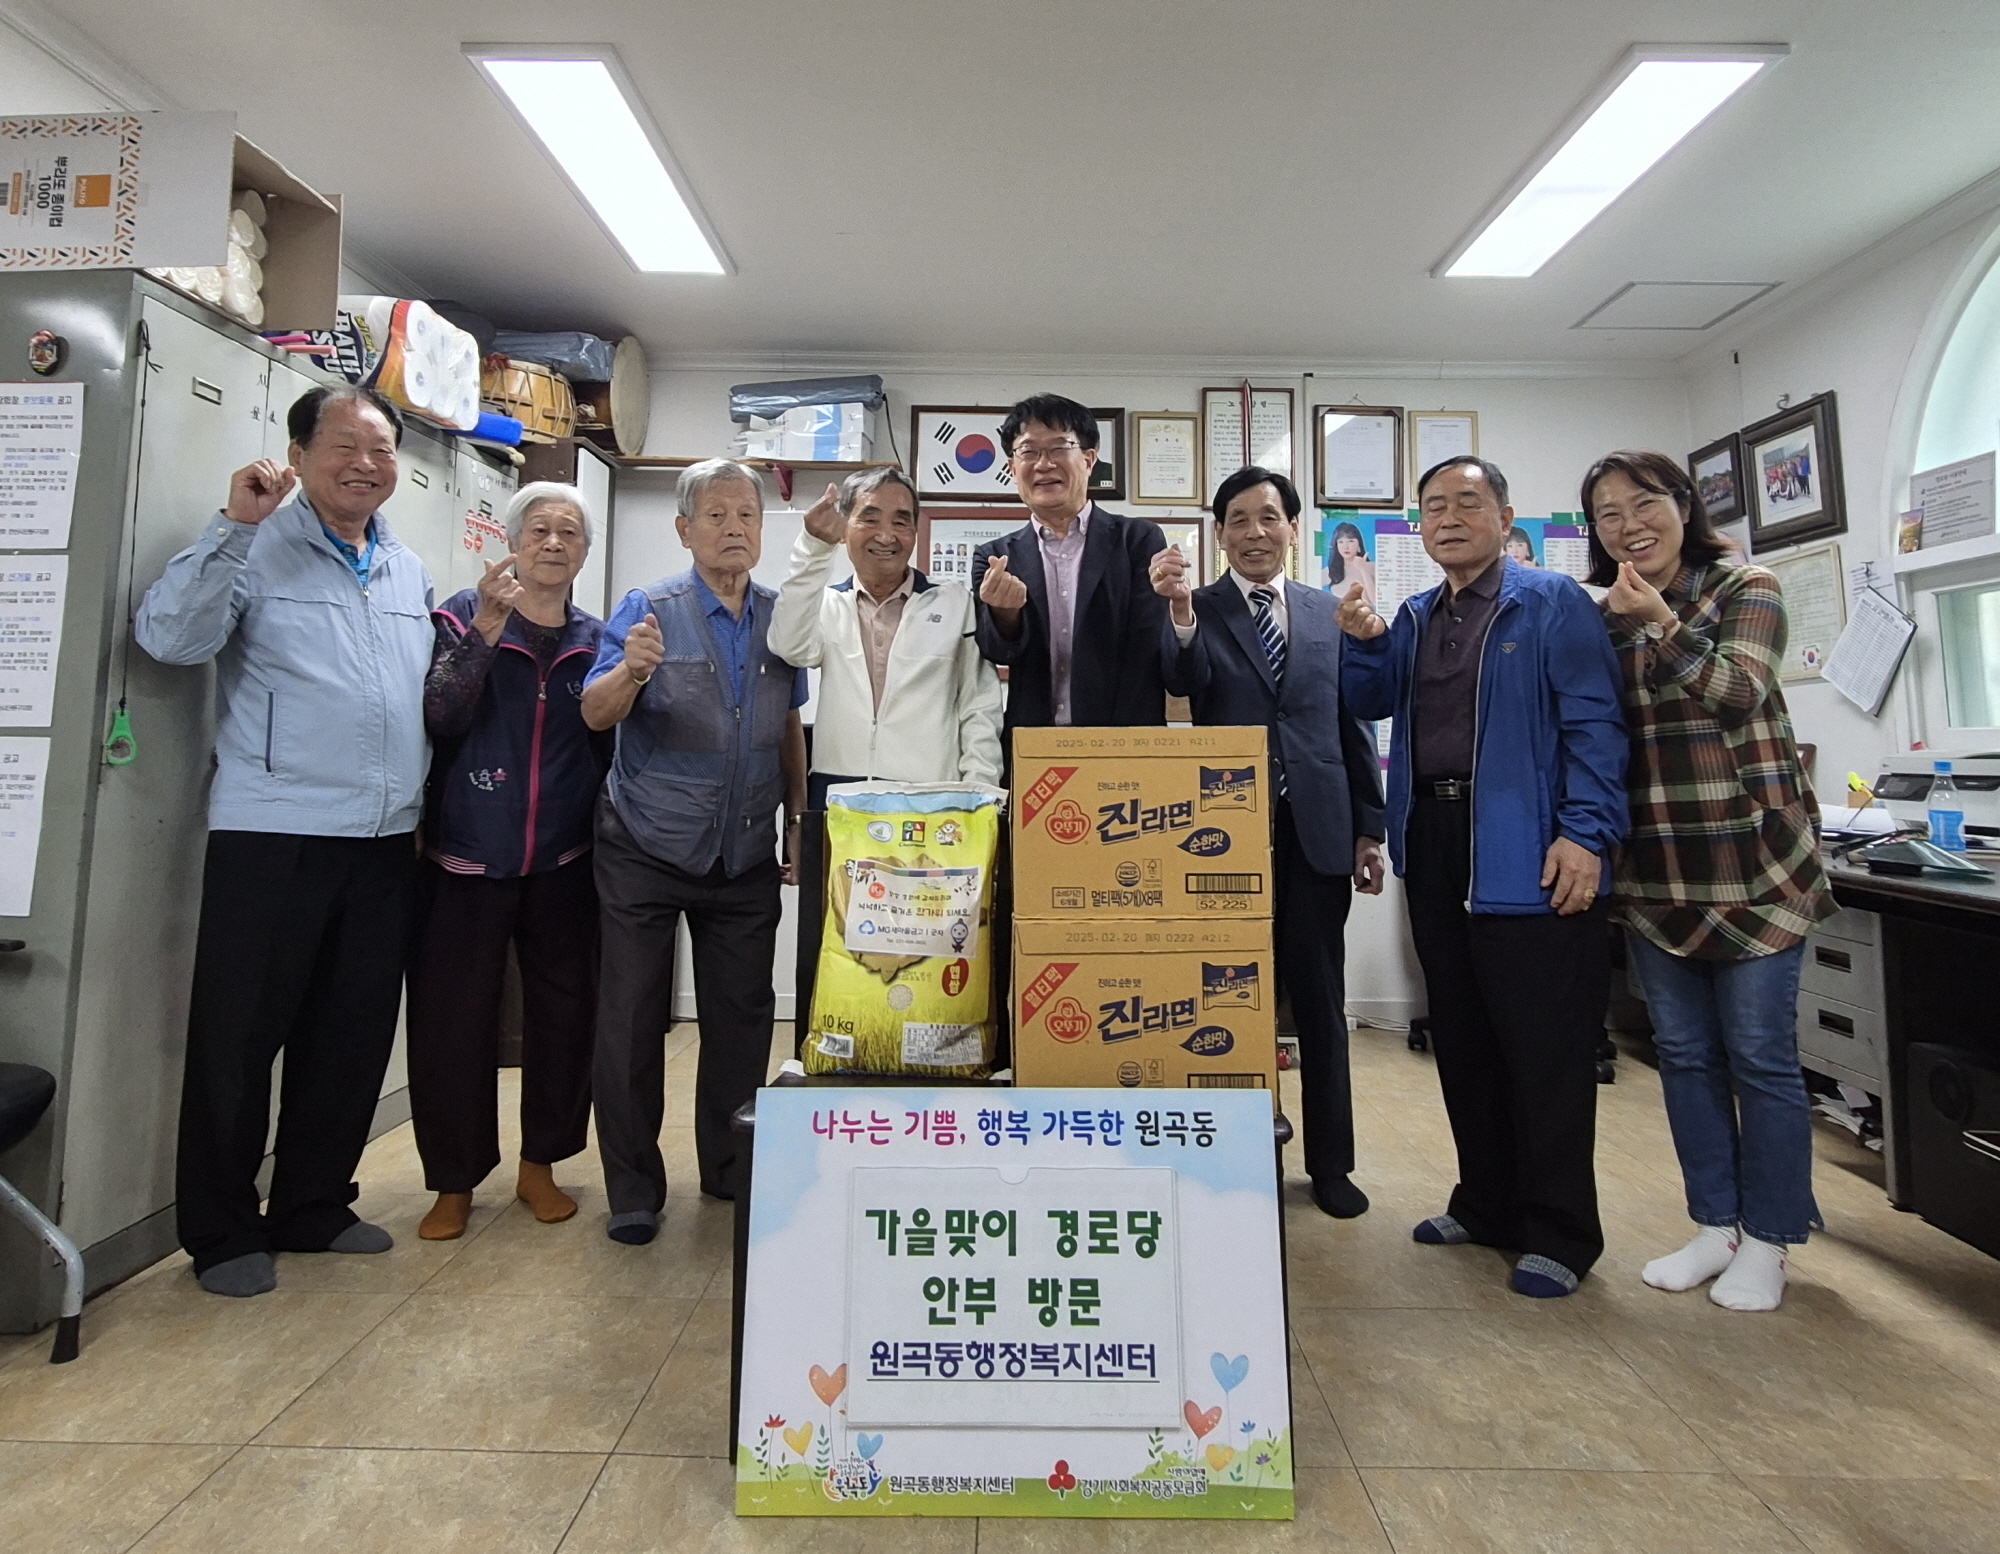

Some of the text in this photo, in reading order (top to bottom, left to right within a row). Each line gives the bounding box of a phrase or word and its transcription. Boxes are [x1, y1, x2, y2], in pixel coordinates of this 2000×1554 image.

[36, 176, 51, 209] 1000
[49, 156, 68, 227] 뿌리또 종이컵
[335, 313, 362, 377] BATH
[1408, 522, 1421, 532] TJ
[1154, 737, 1181, 747] 0221
[1024, 770, 1063, 811] 멀티팩
[1097, 781, 1116, 791] 진하고
[1117, 781, 1130, 791] 순한
[1208, 779, 1246, 797] 진라면
[1053, 820, 1083, 834] 오뚜기
[1096, 797, 1194, 846] 진라면
[1189, 831, 1225, 853] 순한맛
[915, 906, 944, 917] 한가위
[1200, 899, 1248, 909] 52 225
[1166, 933, 1194, 943] 0222
[1202, 933, 1231, 943] A212
[1024, 966, 1064, 1008] 멀티팩
[1098, 977, 1117, 988] 진하고
[1118, 977, 1132, 988] 순한
[1211, 977, 1249, 995] 진라면
[823, 1014, 854, 1034] 10 kg
[1053, 1019, 1084, 1032] 오뚜기
[1098, 995, 1197, 1045] 진라면
[1191, 1029, 1227, 1053] 순한맛
[811, 1109, 1218, 1147] 나누는 기쁨, 행복 가득한 원곡동
[865, 1208, 1163, 1259] 가을맞이 경로당
[921, 1276, 1102, 1328] 안부 방문
[869, 1339, 1158, 1379] 원곡동행정복지센터
[889, 1475, 1015, 1495] 원곡동행정복지센터
[1080, 1478, 1208, 1497] 경기 사회복지공동모금회
